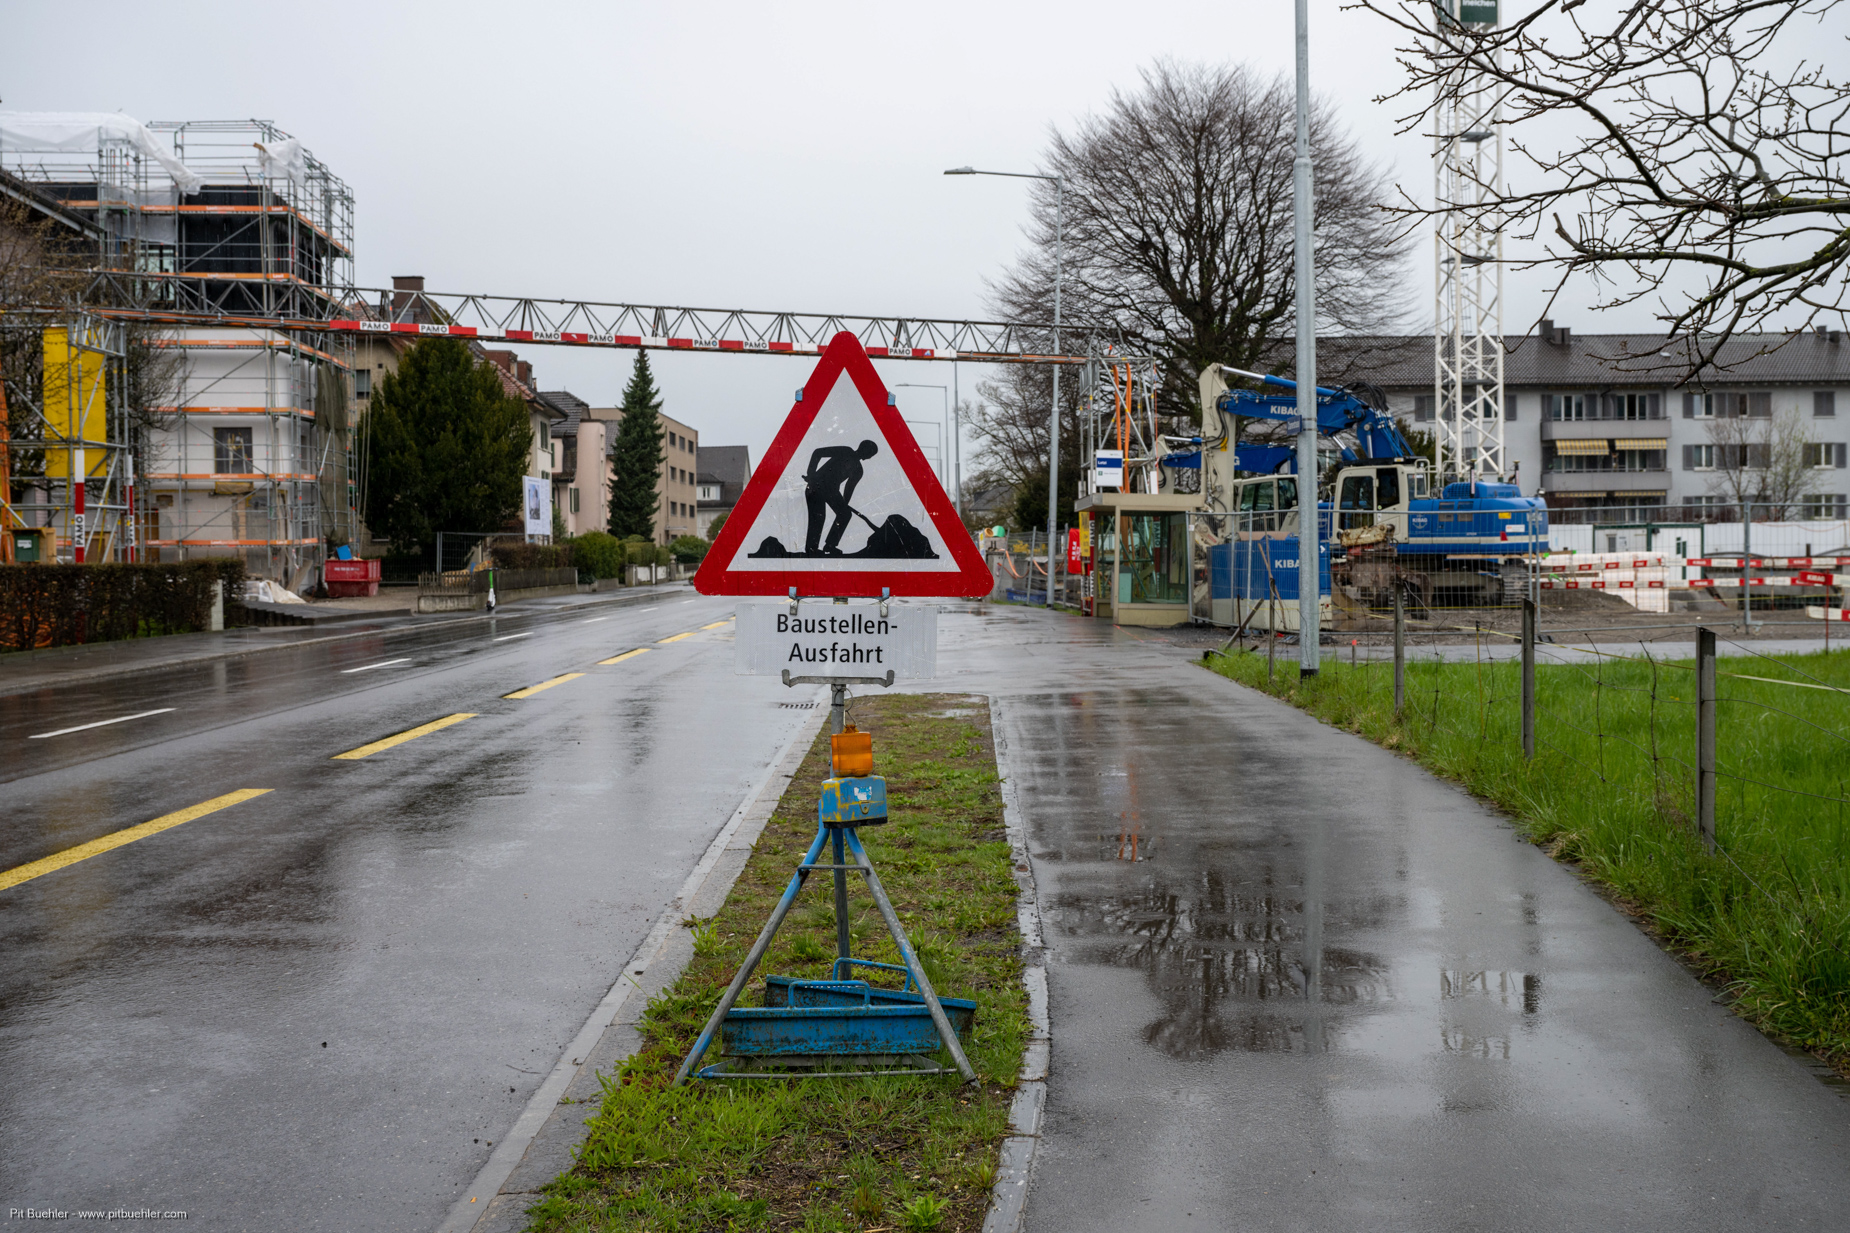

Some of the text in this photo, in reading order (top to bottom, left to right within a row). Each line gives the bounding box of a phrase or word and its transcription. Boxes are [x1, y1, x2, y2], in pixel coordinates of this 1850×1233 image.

[361, 322, 389, 330] PAMO
[420, 325, 448, 333] PAMO
[534, 332, 560, 340] PAMO
[589, 334, 614, 342] PAMO
[744, 341, 767, 349] PAMO
[889, 348, 911, 356] PAMO
[75, 515, 84, 546] PAMO
[776, 613, 898, 635] Baustellen-
[788, 642, 883, 664] Ausfahrt
